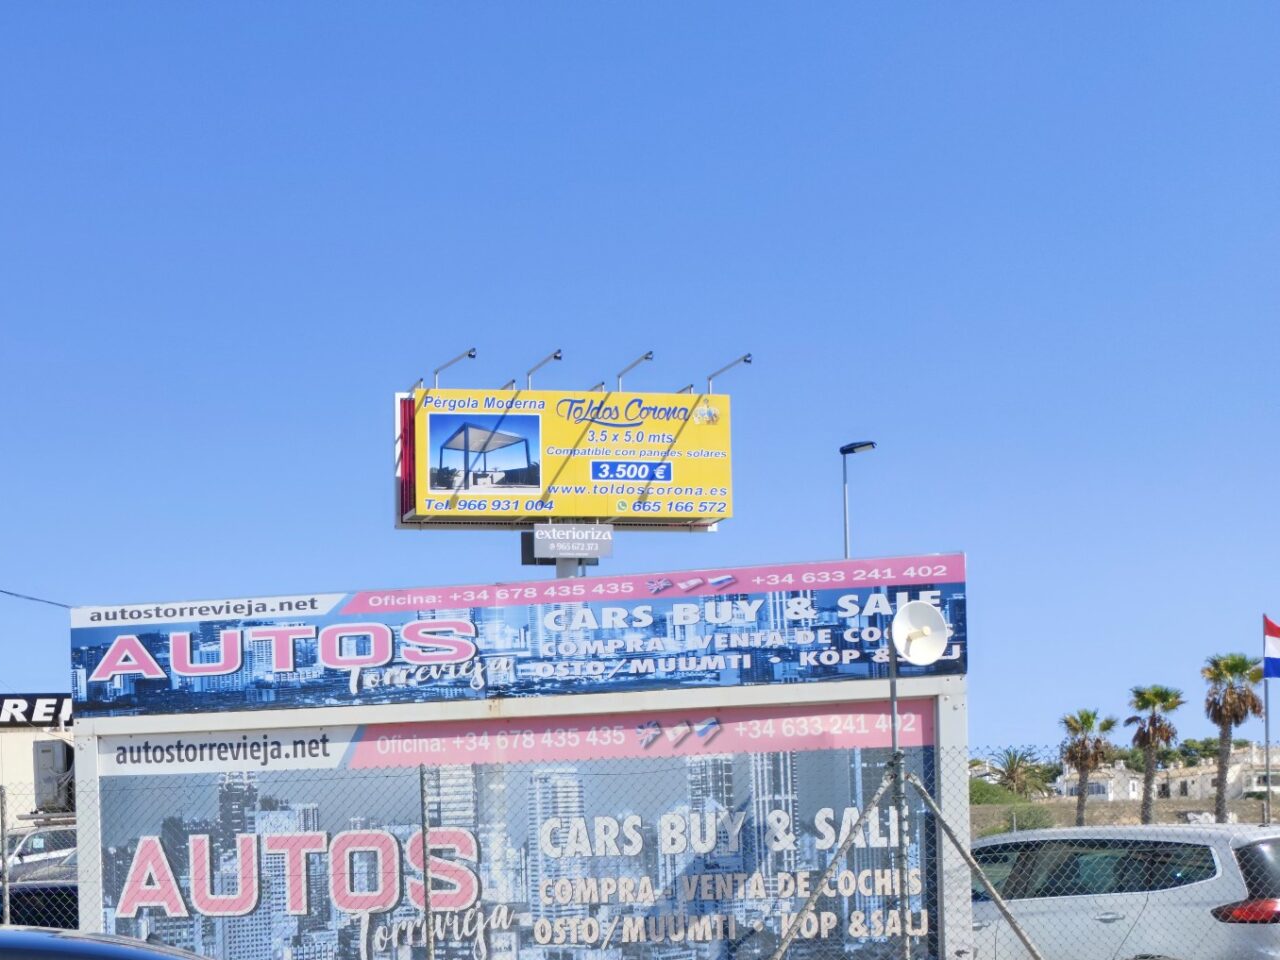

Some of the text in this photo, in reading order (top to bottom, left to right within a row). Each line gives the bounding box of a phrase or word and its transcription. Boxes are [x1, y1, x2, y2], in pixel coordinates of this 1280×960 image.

[424, 396, 545, 410] Pérgola Moderna
[557, 399, 689, 424] Toldos Corona
[546, 446, 611, 458] Compatible
[639, 449, 682, 458] paneles
[687, 449, 727, 458] solares
[598, 464, 667, 479] 3.500 €
[547, 484, 727, 496] www.toldoscorona.es
[458, 500, 489, 511] 966
[491, 500, 520, 511] 931
[525, 500, 554, 511] 004
[632, 501, 727, 513] 665 166 572
[535, 527, 612, 540] exterioriza
[752, 565, 947, 586] +34 633 241 402
[368, 582, 634, 607] Oficina: +34 678 435 435
[90, 597, 319, 624] autostorrevieja.net
[543, 605, 654, 632] CARS
[672, 599, 765, 625] BUY
[786, 597, 818, 620] &
[89, 620, 477, 681] AUTOS
[542, 637, 665, 656] COMPRA
[693, 630, 786, 650] VENTA
[796, 628, 832, 645] DE
[800, 646, 860, 666] KÖP
[346, 657, 513, 695] Torrevieja
[735, 712, 916, 739] +34 633 241 402
[116, 733, 330, 766] autostorrevieja.net
[376, 725, 625, 755] Oficina: +34 678 435 435
[540, 813, 644, 859] CARS
[660, 811, 746, 855] BUY
[766, 809, 797, 851] &
[116, 827, 480, 918] AUTOS
[539, 876, 655, 905] COMPRA
[682, 872, 767, 900] VENTA
[777, 871, 811, 899] DE
